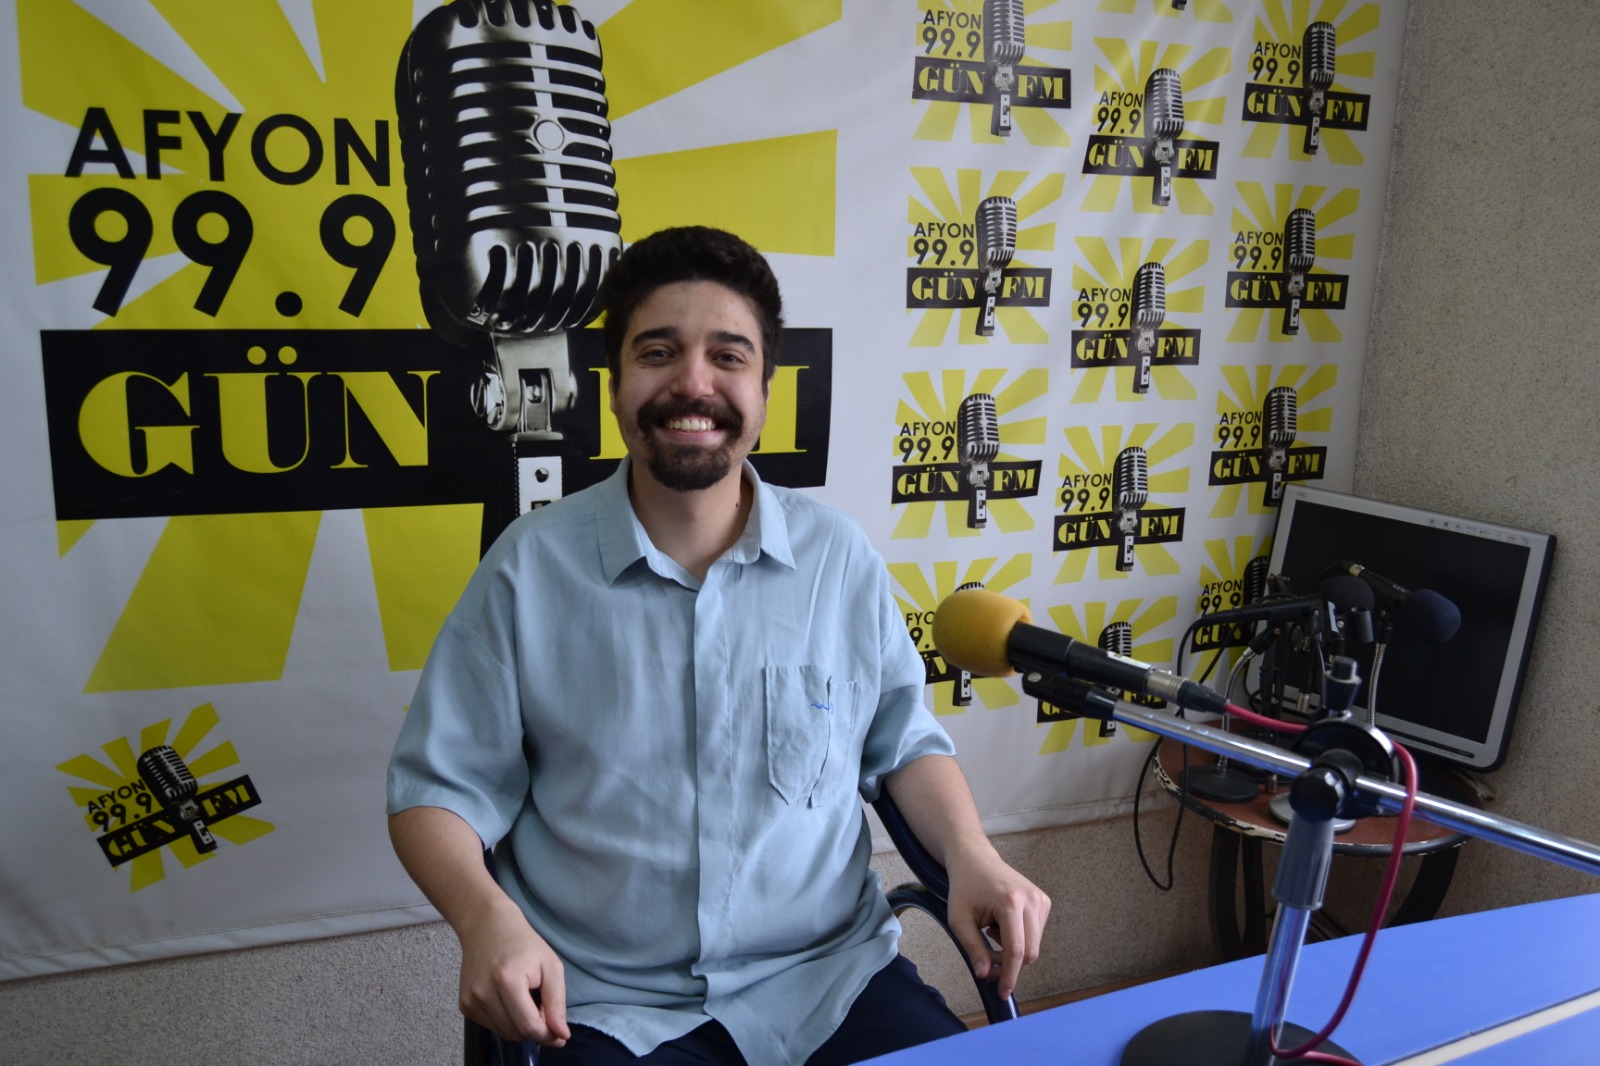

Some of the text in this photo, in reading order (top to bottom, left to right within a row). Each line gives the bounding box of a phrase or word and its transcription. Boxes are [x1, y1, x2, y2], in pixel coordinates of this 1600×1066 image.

[923, 9, 982, 30] AFYON
[922, 26, 981, 58] 99.9
[1254, 41, 1301, 59] AFYON
[918, 63, 1066, 100] GÜN FM
[1252, 56, 1300, 85] 99.9
[1099, 91, 1143, 108] AFYON
[1247, 88, 1365, 123] GÜN FM
[1097, 106, 1141, 135] 99.9
[65, 106, 391, 188] AFYON
[1088, 139, 1215, 171] GÜN FM
[914, 222, 974, 238] AFYON
[1235, 231, 1283, 246] AFYON
[68, 187, 396, 318] 99.9
[913, 238, 975, 266] 99.9
[1234, 245, 1281, 270] 99.9
[911, 271, 1046, 301] GÜN FM
[1077, 288, 1132, 302] AFYON
[1230, 275, 1342, 302] GÜN FM
[1077, 303, 1129, 328] 99.9
[1076, 333, 1196, 360] GÜN FM
[78, 345, 441, 478] GÜN
[1220, 411, 1263, 425] AFYON
[899, 421, 956, 437] AFYON
[1218, 425, 1260, 449] 99.9
[899, 436, 955, 463] 99.9
[1213, 452, 1320, 479] GÜN FM
[897, 466, 1037, 496] GÜN FM
[1062, 473, 1112, 488] AFYON
[1061, 487, 1110, 513] 99.9
[1058, 515, 1181, 544] GÜN FM
[1202, 579, 1243, 596] AFYON
[1200, 592, 1241, 617] 999
[906, 611, 936, 626] FYO
[87, 779, 146, 815] AFYON
[92, 792, 152, 833] 99.9
[108, 783, 251, 857] GÜN FM
